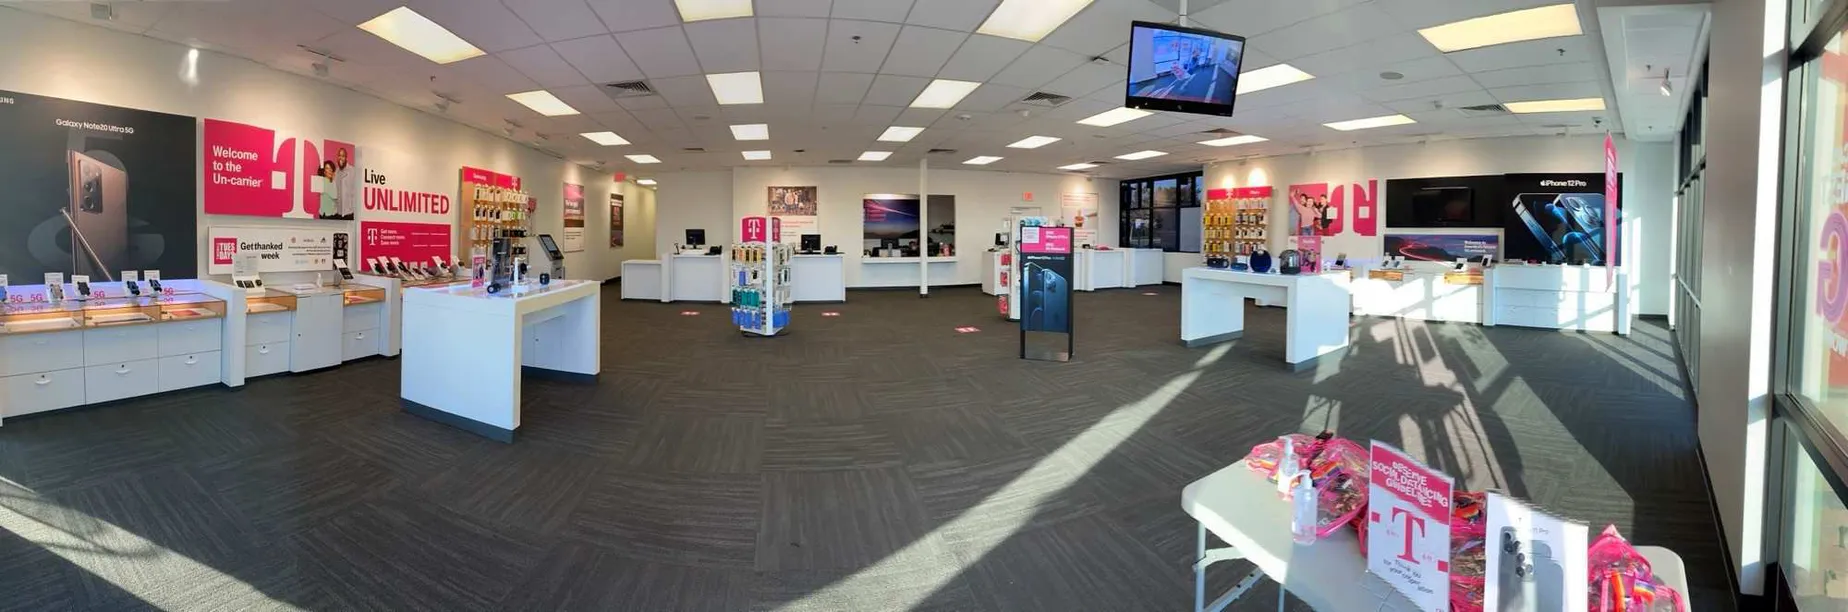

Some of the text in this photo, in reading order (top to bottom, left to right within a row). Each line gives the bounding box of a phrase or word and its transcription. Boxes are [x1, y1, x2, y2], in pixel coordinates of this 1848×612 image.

[55, 118, 82, 130] Galaxy
[108, 124, 124, 133] Ultra
[124, 126, 134, 134] 5G
[212, 145, 258, 161] Welcome
[212, 161, 242, 172] to the
[212, 172, 262, 187] Un-carrier
[364, 168, 386, 185] Live
[1544, 179, 1567, 187] iPhone
[364, 187, 450, 215] UNLIMITED
[748, 219, 761, 239] T
[368, 228, 378, 246] T
[240, 242, 254, 250] Get
[254, 242, 283, 250] thanked
[260, 251, 280, 260] week
[10, 294, 23, 303] 5G
[30, 293, 43, 302] 5G
[94, 289, 105, 298] 5G
[1372, 460, 1399, 482] SOCIAL
[1391, 506, 1426, 565] T
